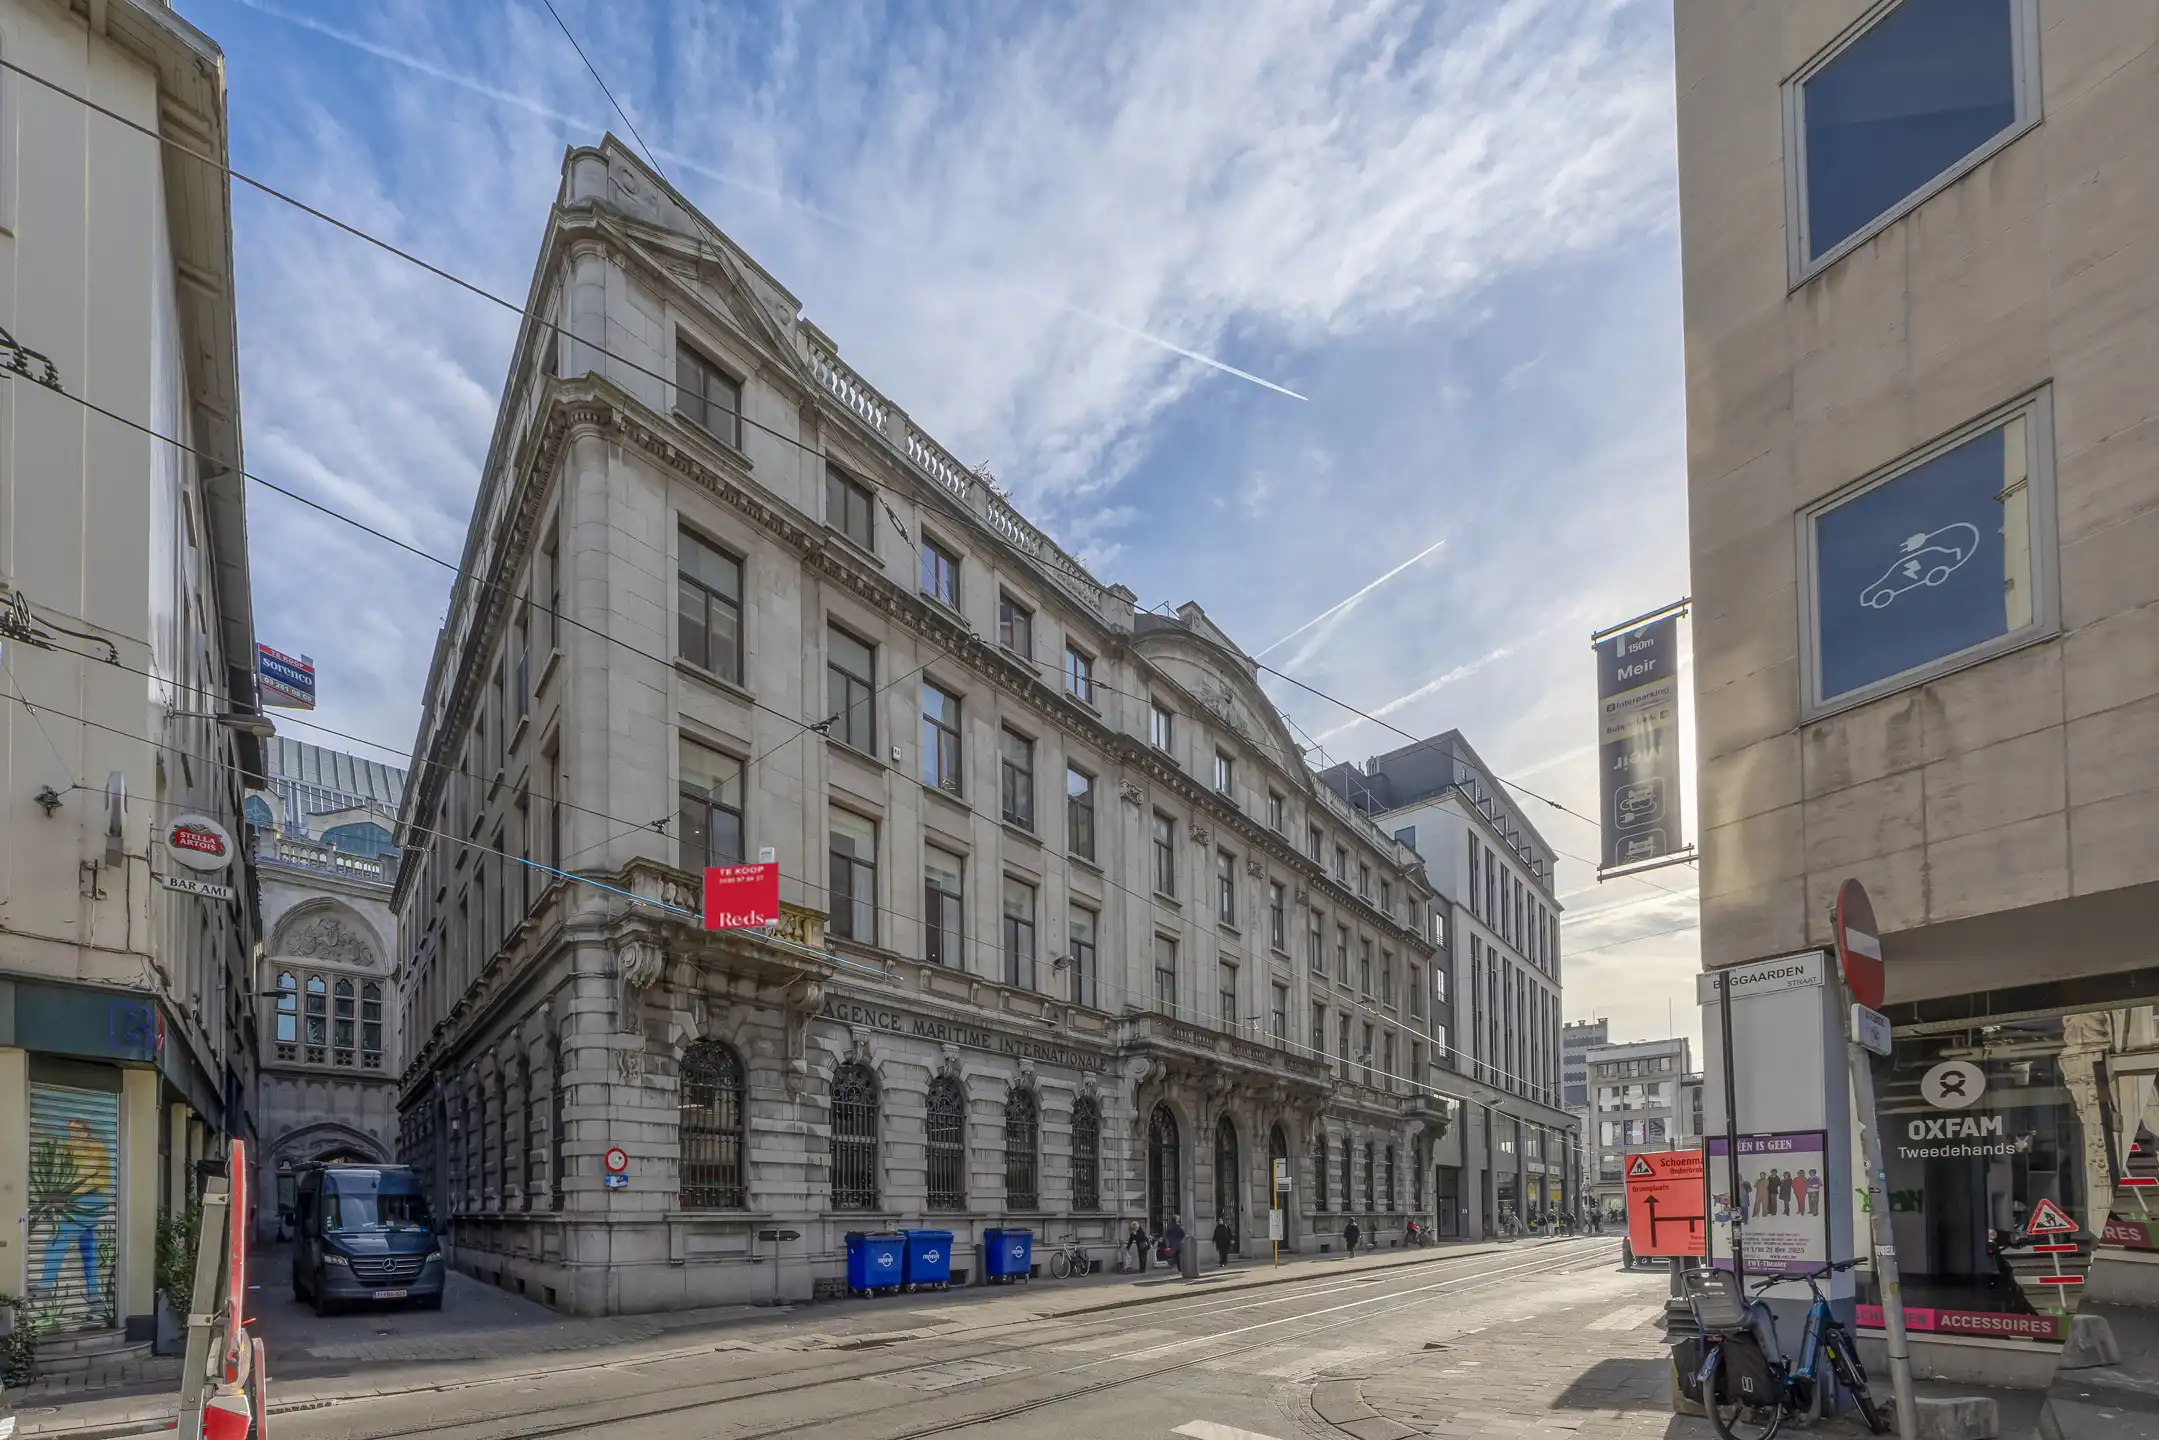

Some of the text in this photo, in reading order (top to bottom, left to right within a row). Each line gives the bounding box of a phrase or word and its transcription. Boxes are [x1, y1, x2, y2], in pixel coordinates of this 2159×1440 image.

[1628, 639, 1654, 654] 150m
[282, 656, 304, 668] KOOP
[1617, 659, 1657, 681] Meir
[262, 657, 313, 686] sorenco
[1616, 685, 1670, 710] Interparking
[180, 831, 216, 845] STELLA
[180, 838, 217, 851] ARTOIS
[720, 866, 765, 876] TE KOOP
[169, 877, 227, 897] BAR AMI
[719, 910, 765, 928] Reds
[1713, 965, 1804, 989] BGGAARDEN
[1787, 976, 1817, 987] STRAAT
[820, 1000, 1107, 1072] AGENCE MARITIME INTERNATIONALE
[1908, 1115, 2003, 1140] OXFAM
[1755, 1141, 1765, 1151] IS
[1767, 1139, 1792, 1151] GEEN
[1897, 1142, 2016, 1159] Tweedehands
[1940, 1315, 2052, 1333] ACCESSOIRES
